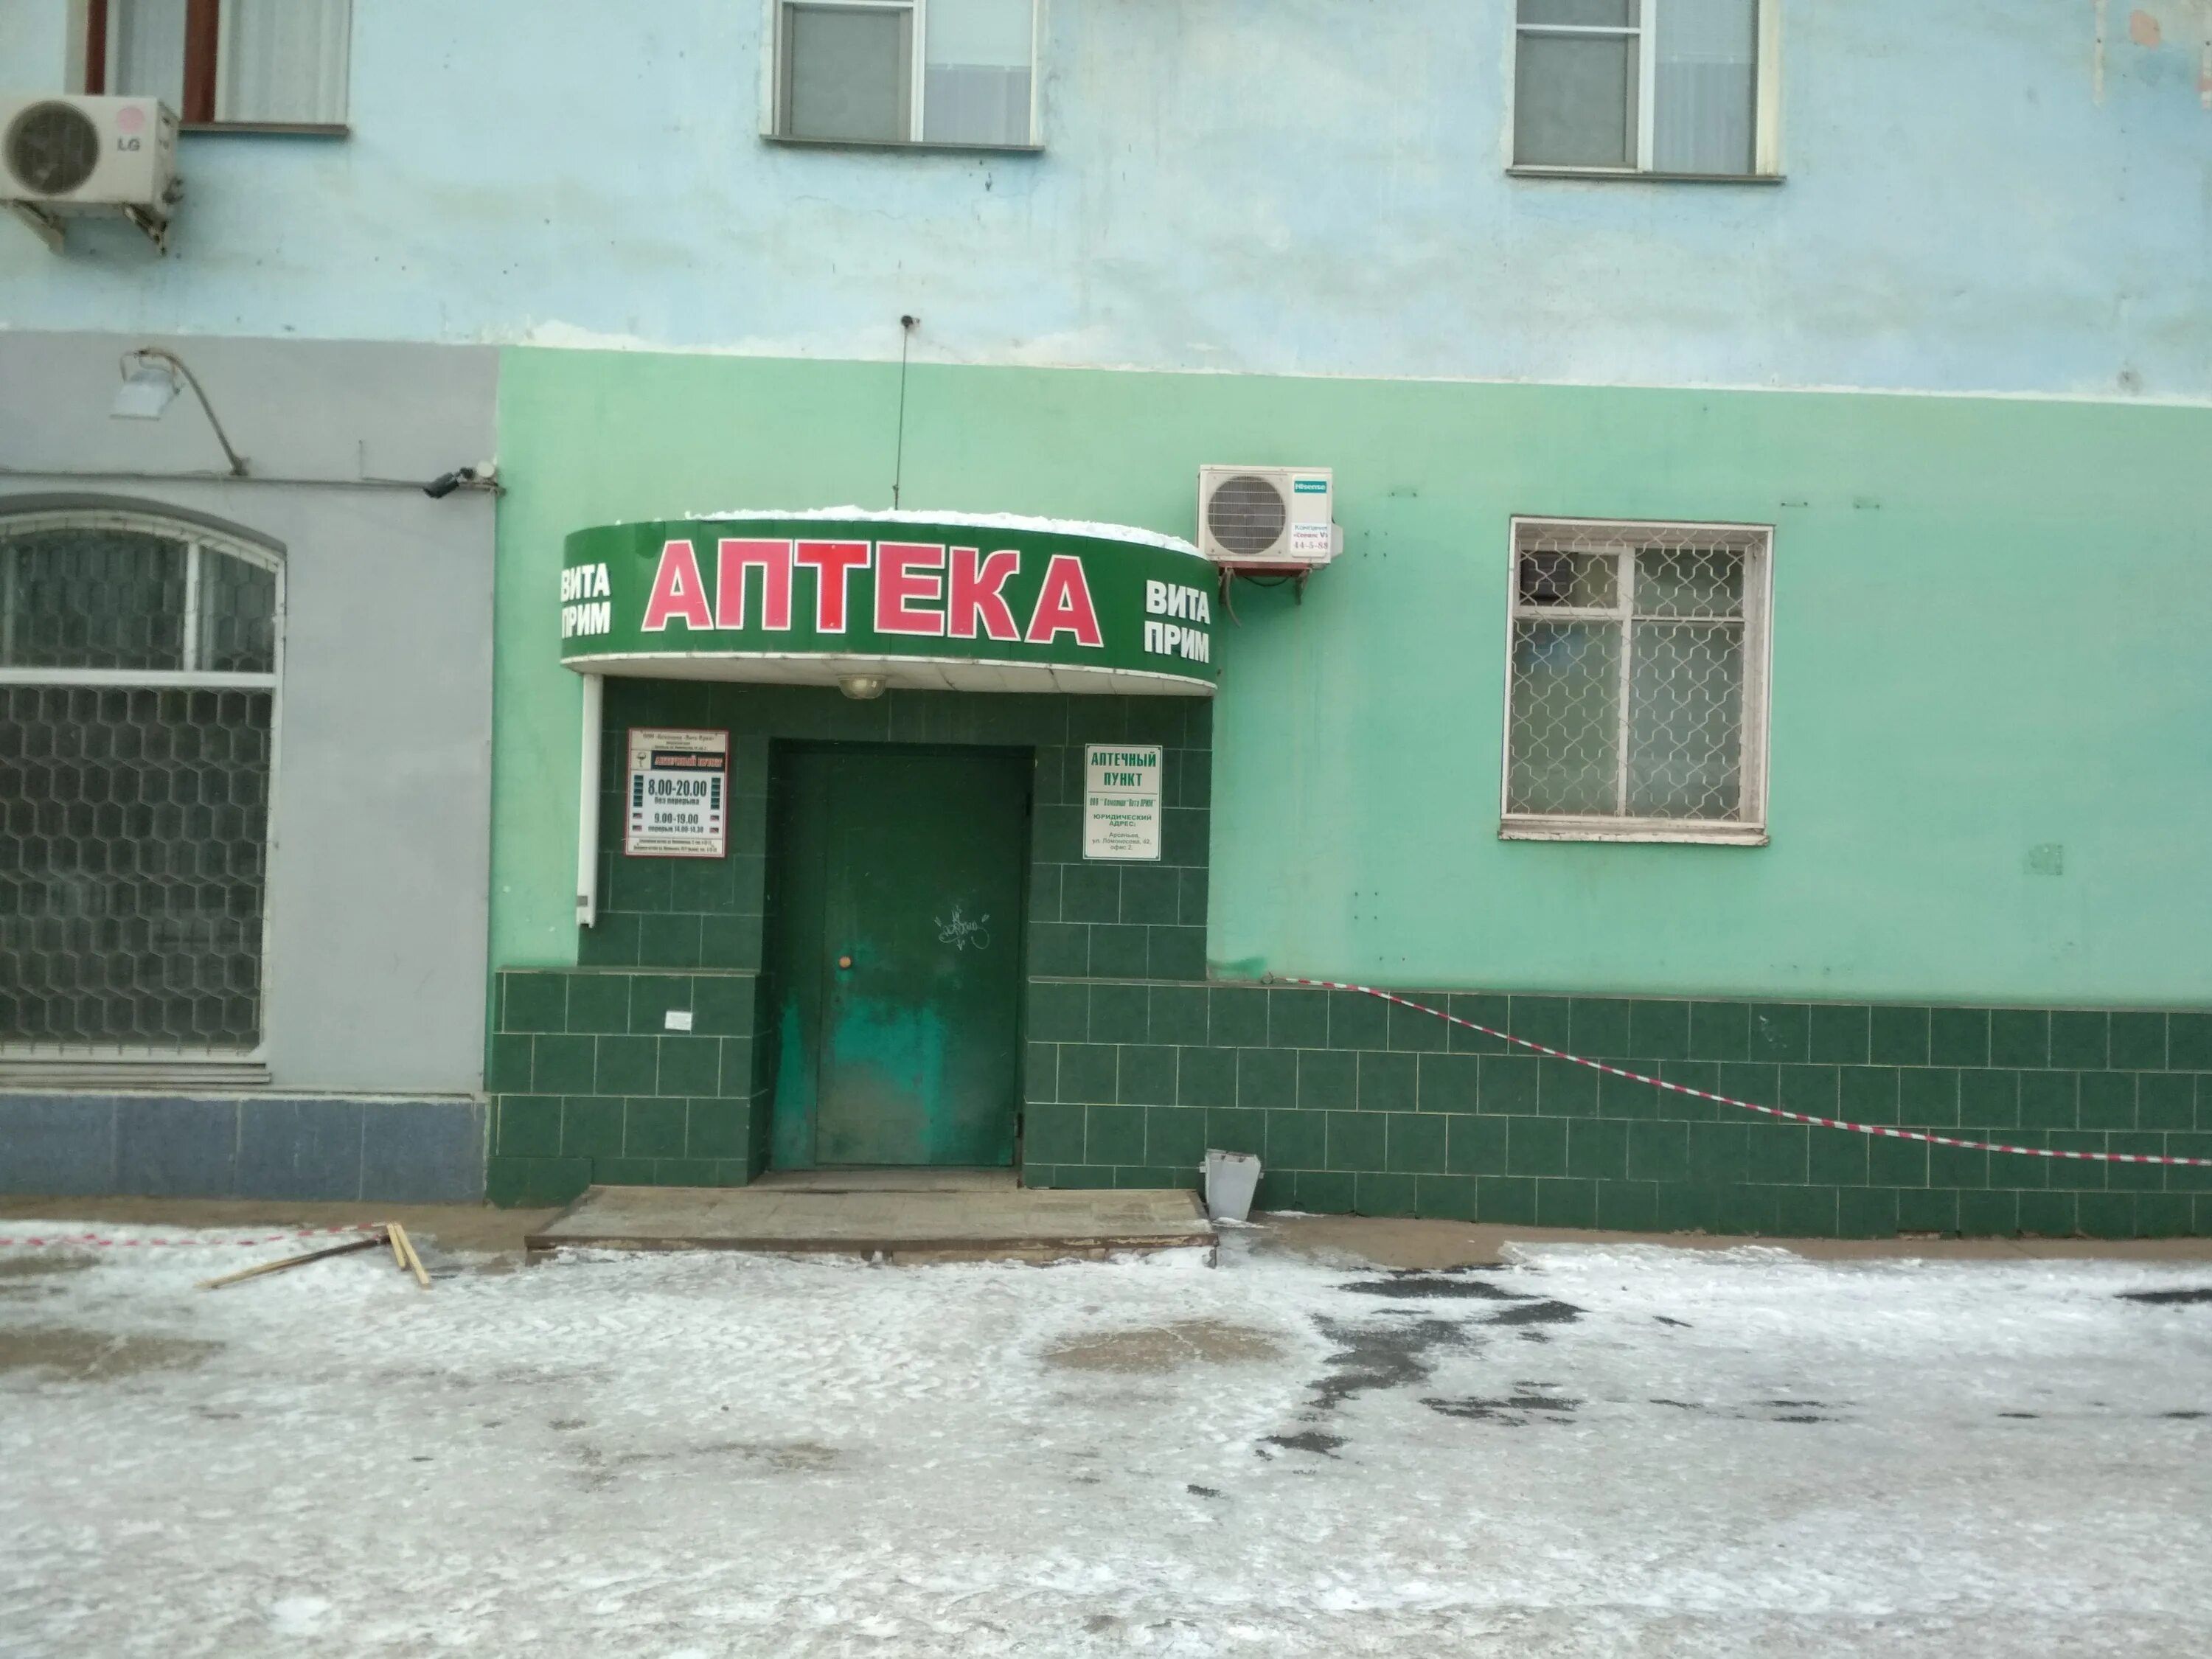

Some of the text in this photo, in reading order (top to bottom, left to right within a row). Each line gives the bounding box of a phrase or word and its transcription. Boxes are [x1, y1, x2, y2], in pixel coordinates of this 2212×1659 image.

[118, 138, 141, 152] LG
[560, 563, 610, 602] ВИТА
[641, 538, 1104, 647] АПТЕКА
[1147, 580, 1210, 625] ВИТА
[561, 602, 611, 639] ПРИМ
[1144, 620, 1209, 663] ПРИМ
[1091, 751, 1156, 767] АПТЕЧНЫЙ
[648, 779, 707, 796] 8.00-20.00
[1104, 772, 1142, 787] ПУНКТ
[655, 796, 700, 806] без перерыва
